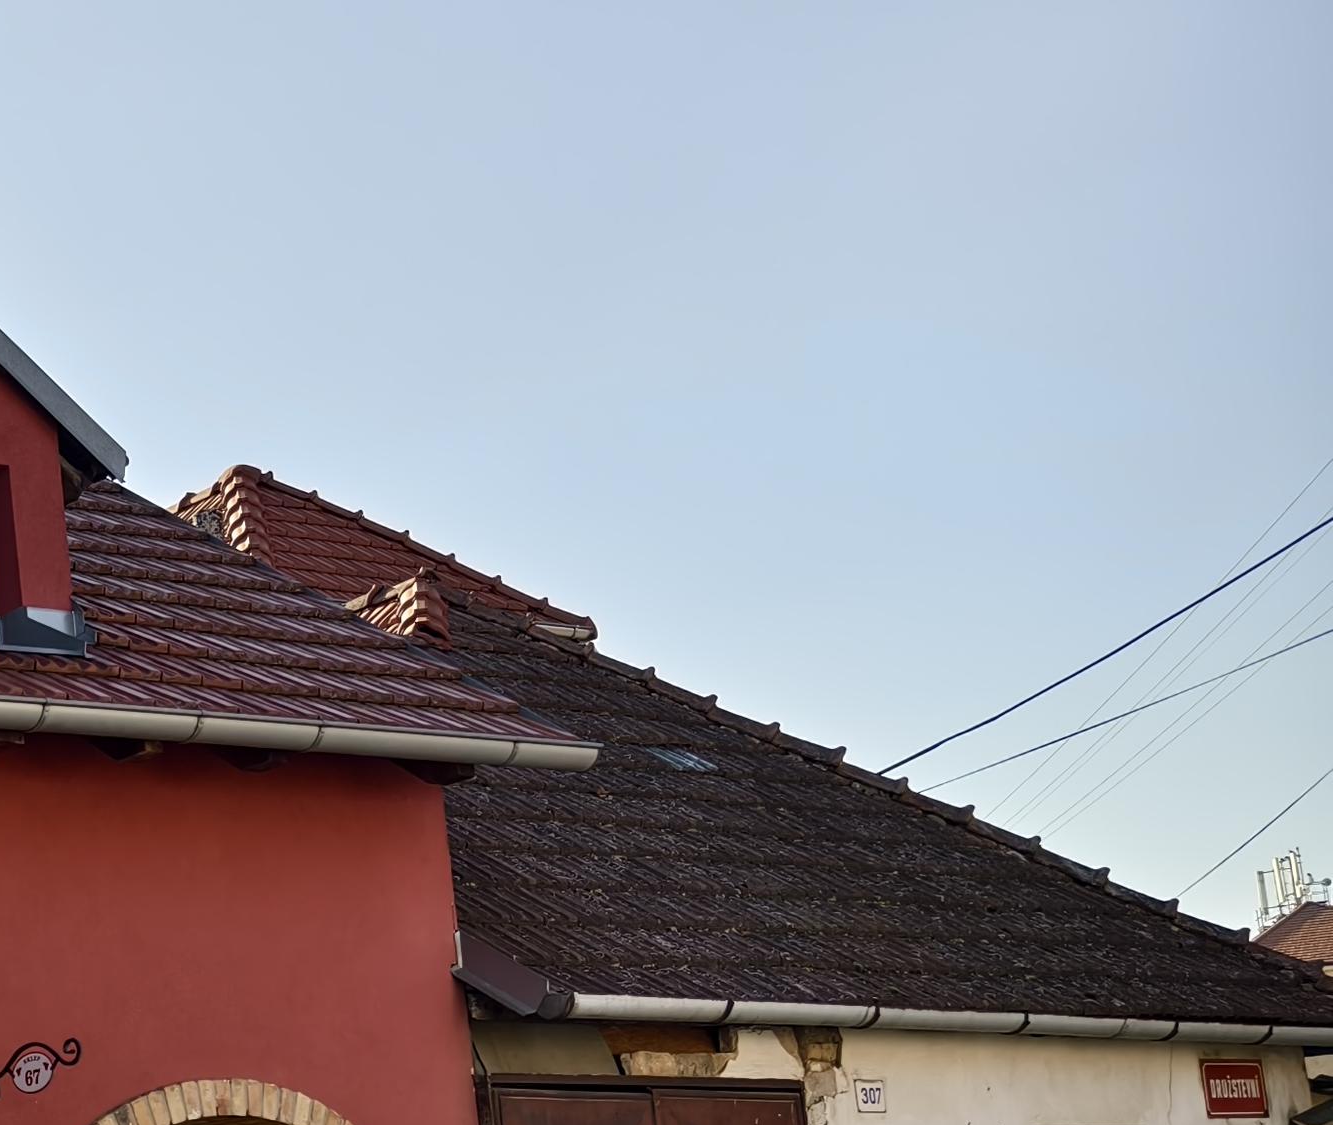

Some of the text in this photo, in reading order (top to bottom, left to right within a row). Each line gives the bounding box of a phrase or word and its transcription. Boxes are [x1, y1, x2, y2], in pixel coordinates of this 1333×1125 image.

[25, 1068, 41, 1086] 67
[860, 1087, 881, 1105] 307
[1209, 1075, 1261, 1099] DRUŽSTEVNÍ
